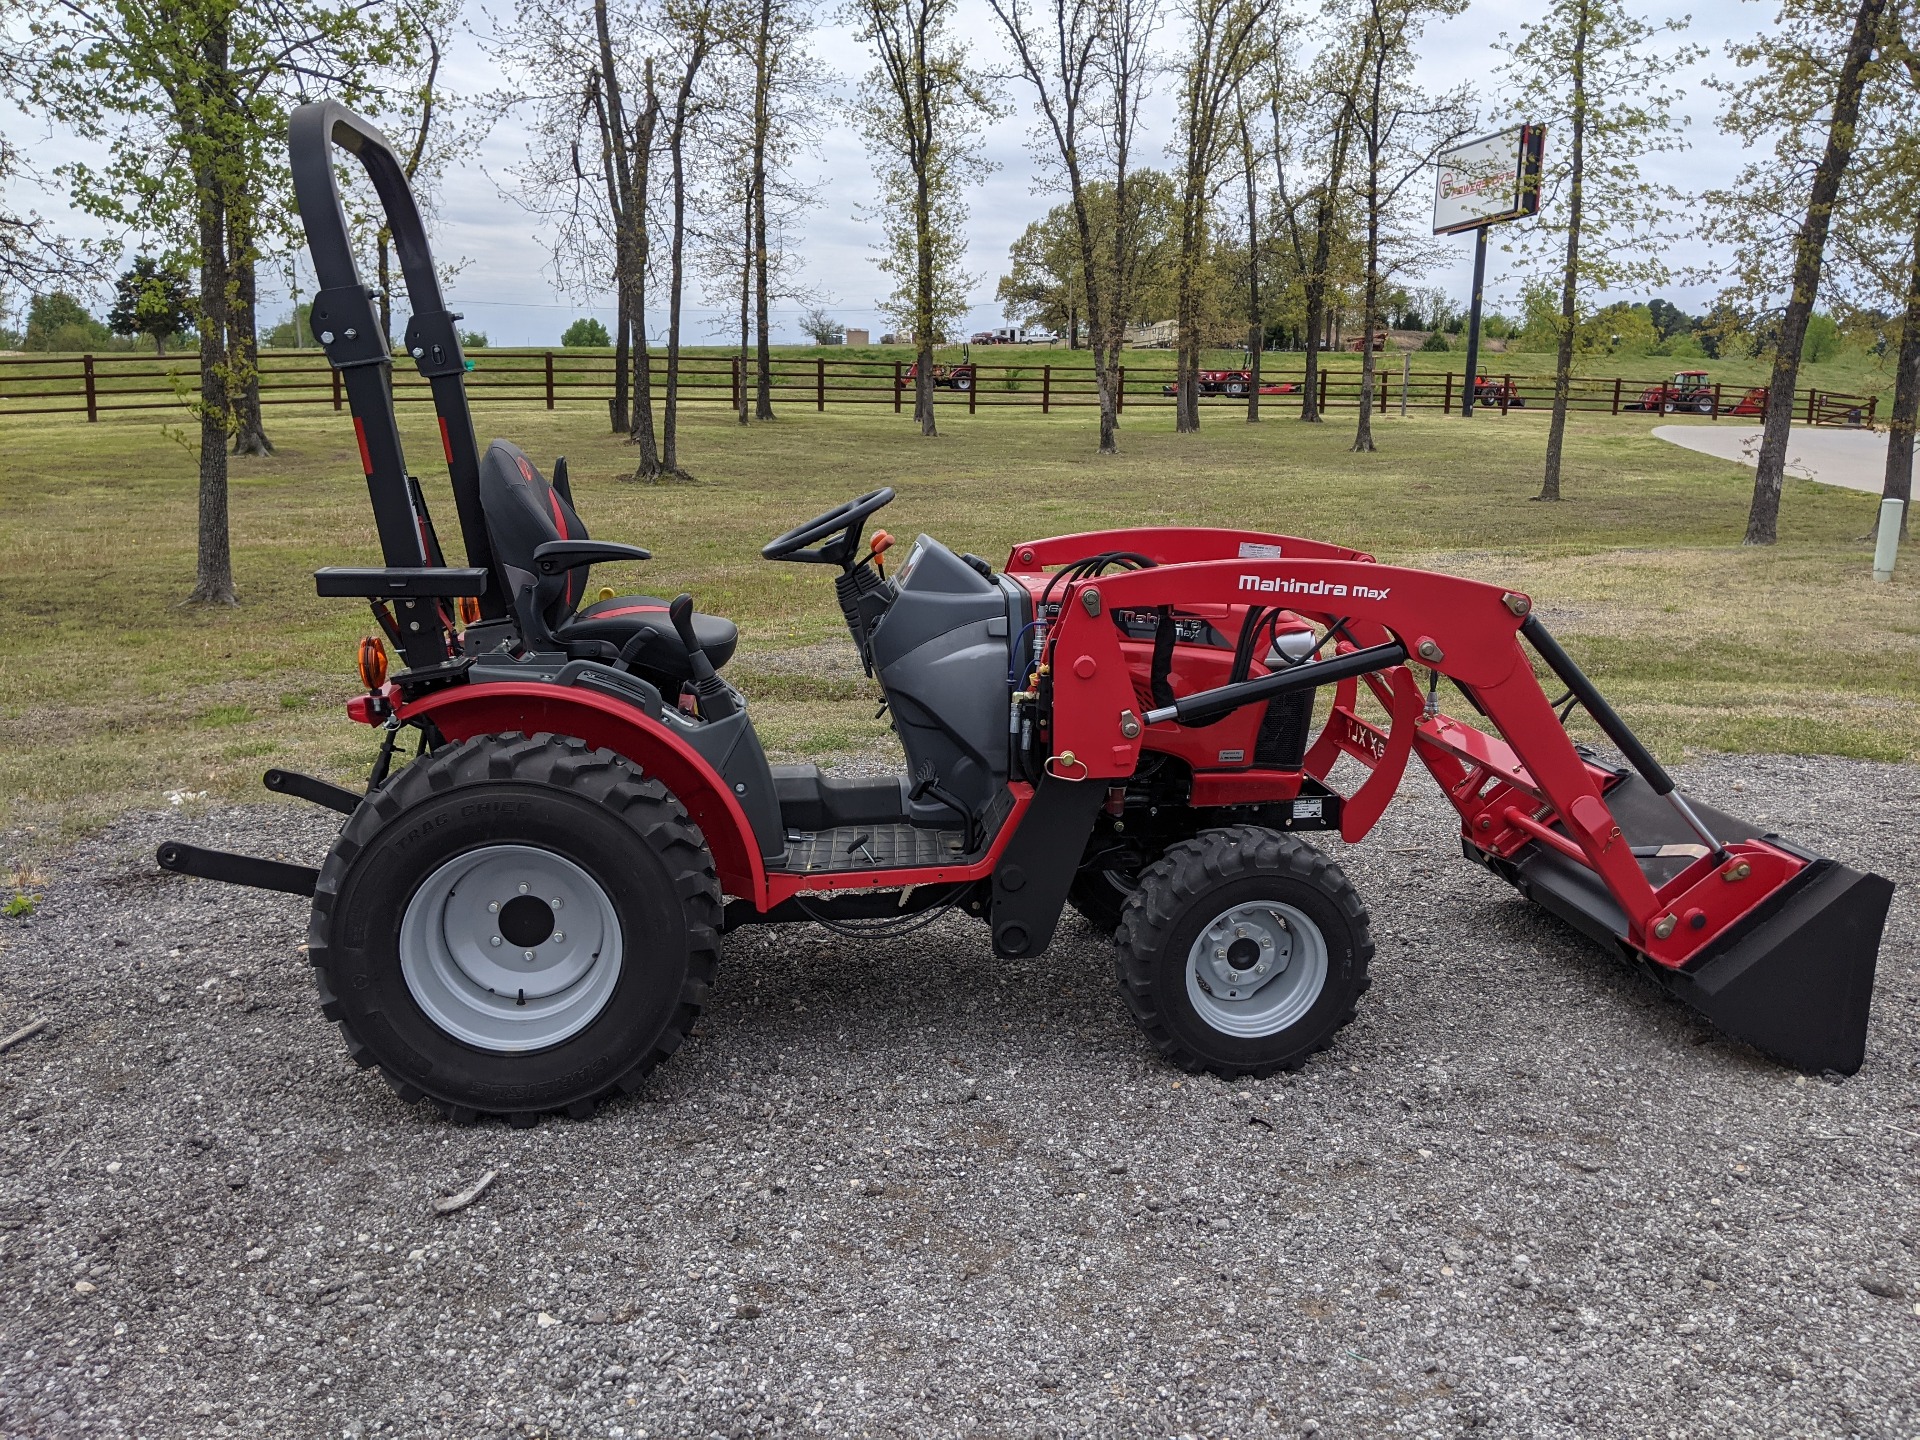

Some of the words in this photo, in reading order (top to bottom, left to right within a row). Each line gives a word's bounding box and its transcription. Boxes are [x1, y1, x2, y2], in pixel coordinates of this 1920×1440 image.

[1238, 574, 1348, 596] Mahindra
[1352, 585, 1391, 601] Max
[395, 812, 449, 849] TRAC
[461, 801, 532, 818] CHIEF
